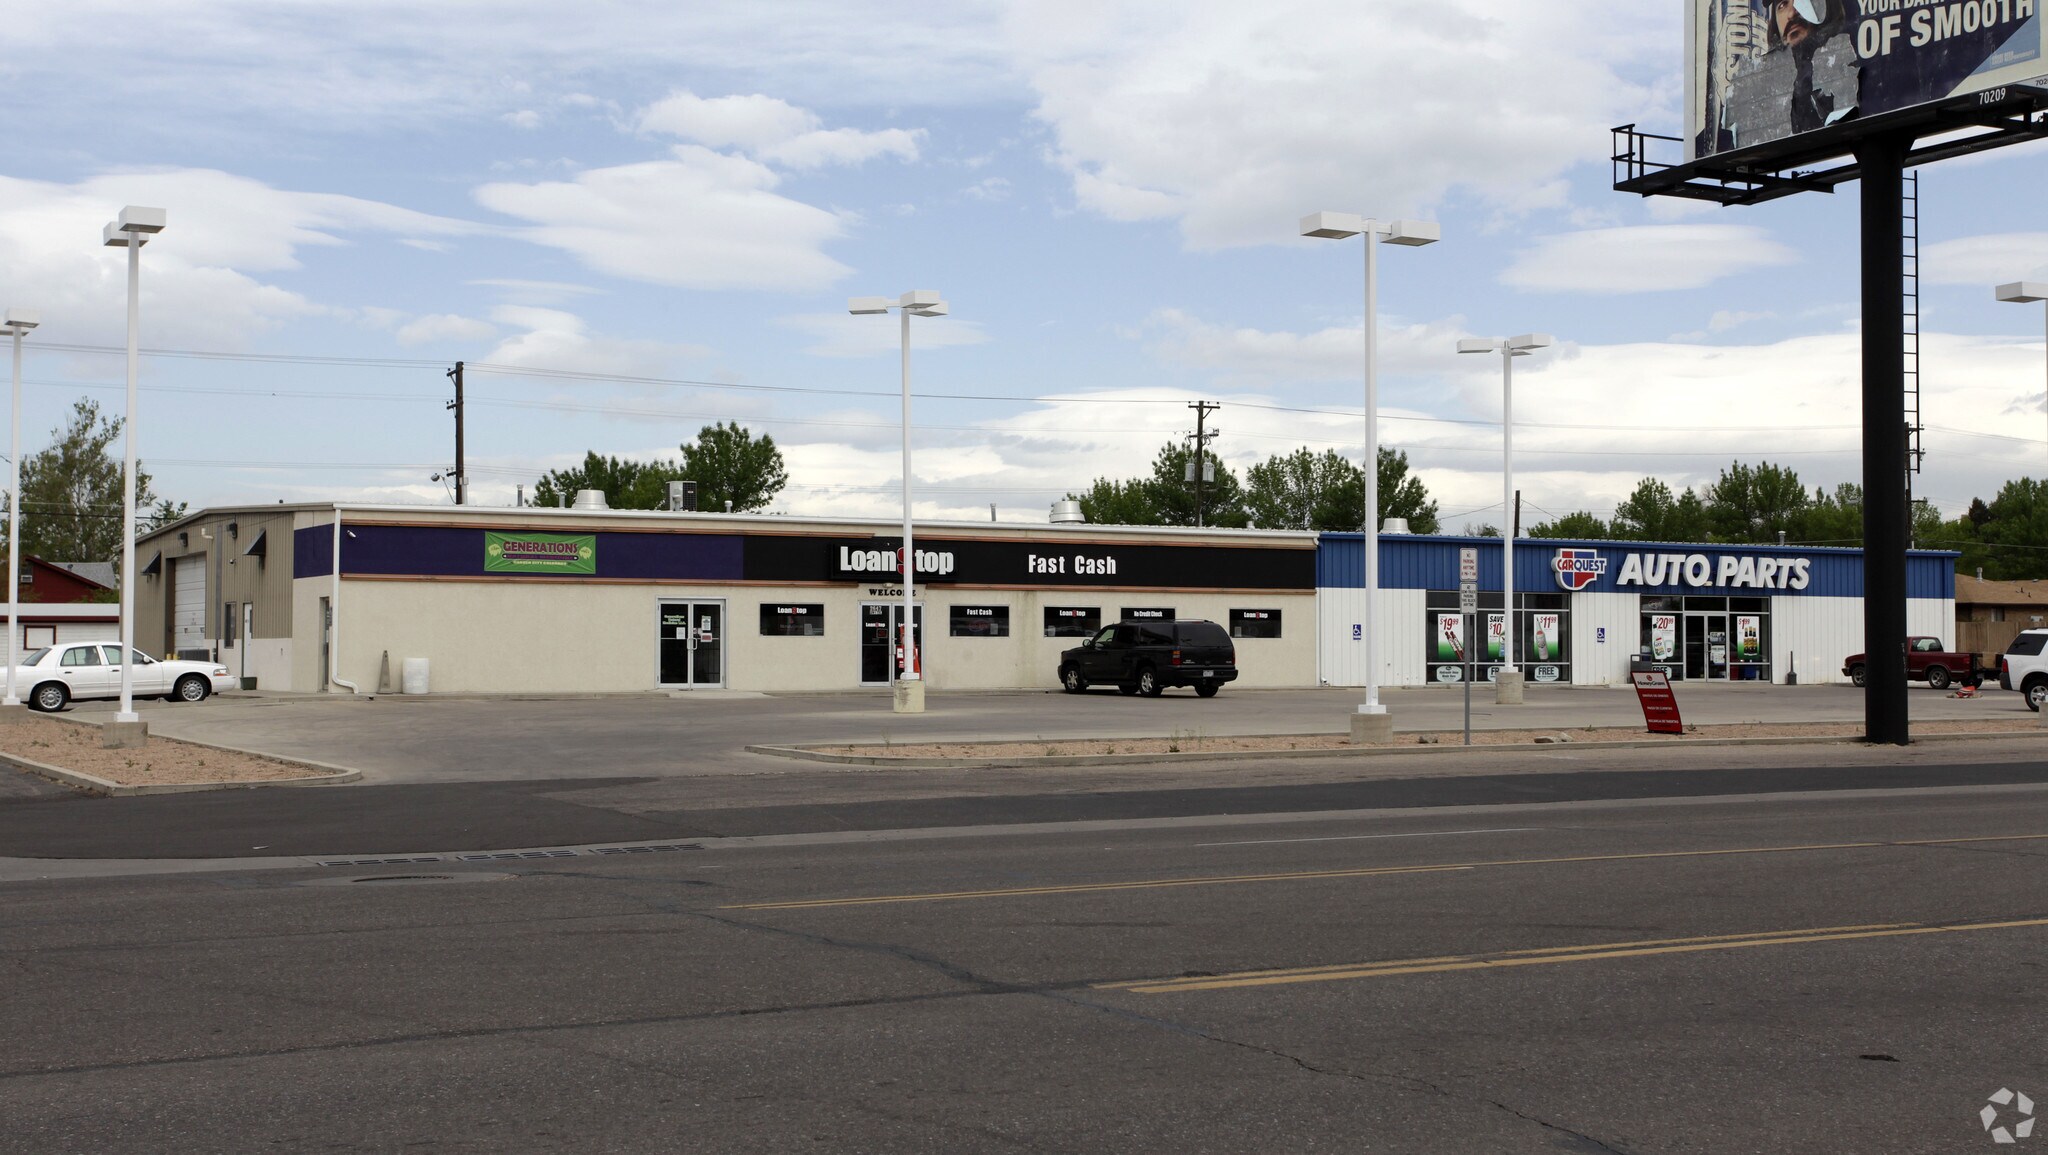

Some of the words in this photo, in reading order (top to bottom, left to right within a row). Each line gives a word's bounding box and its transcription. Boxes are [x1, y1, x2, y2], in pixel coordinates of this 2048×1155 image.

[1857, 15, 1901, 59] OF
[1910, 0, 2033, 47] SMOOTH
[1979, 87, 2006, 105] 70209
[503, 541, 578, 554] GENERATIONS
[1028, 554, 1065, 574] Fast
[1074, 555, 1116, 575] Cash
[1556, 559, 1605, 572] CARQUEST
[1616, 553, 1711, 587] AUTO
[1715, 556, 1811, 590] PARTS
[868, 588, 916, 597] WELCOE
[1489, 615, 1504, 623] SAVE
[1538, 666, 1555, 676] FREE
